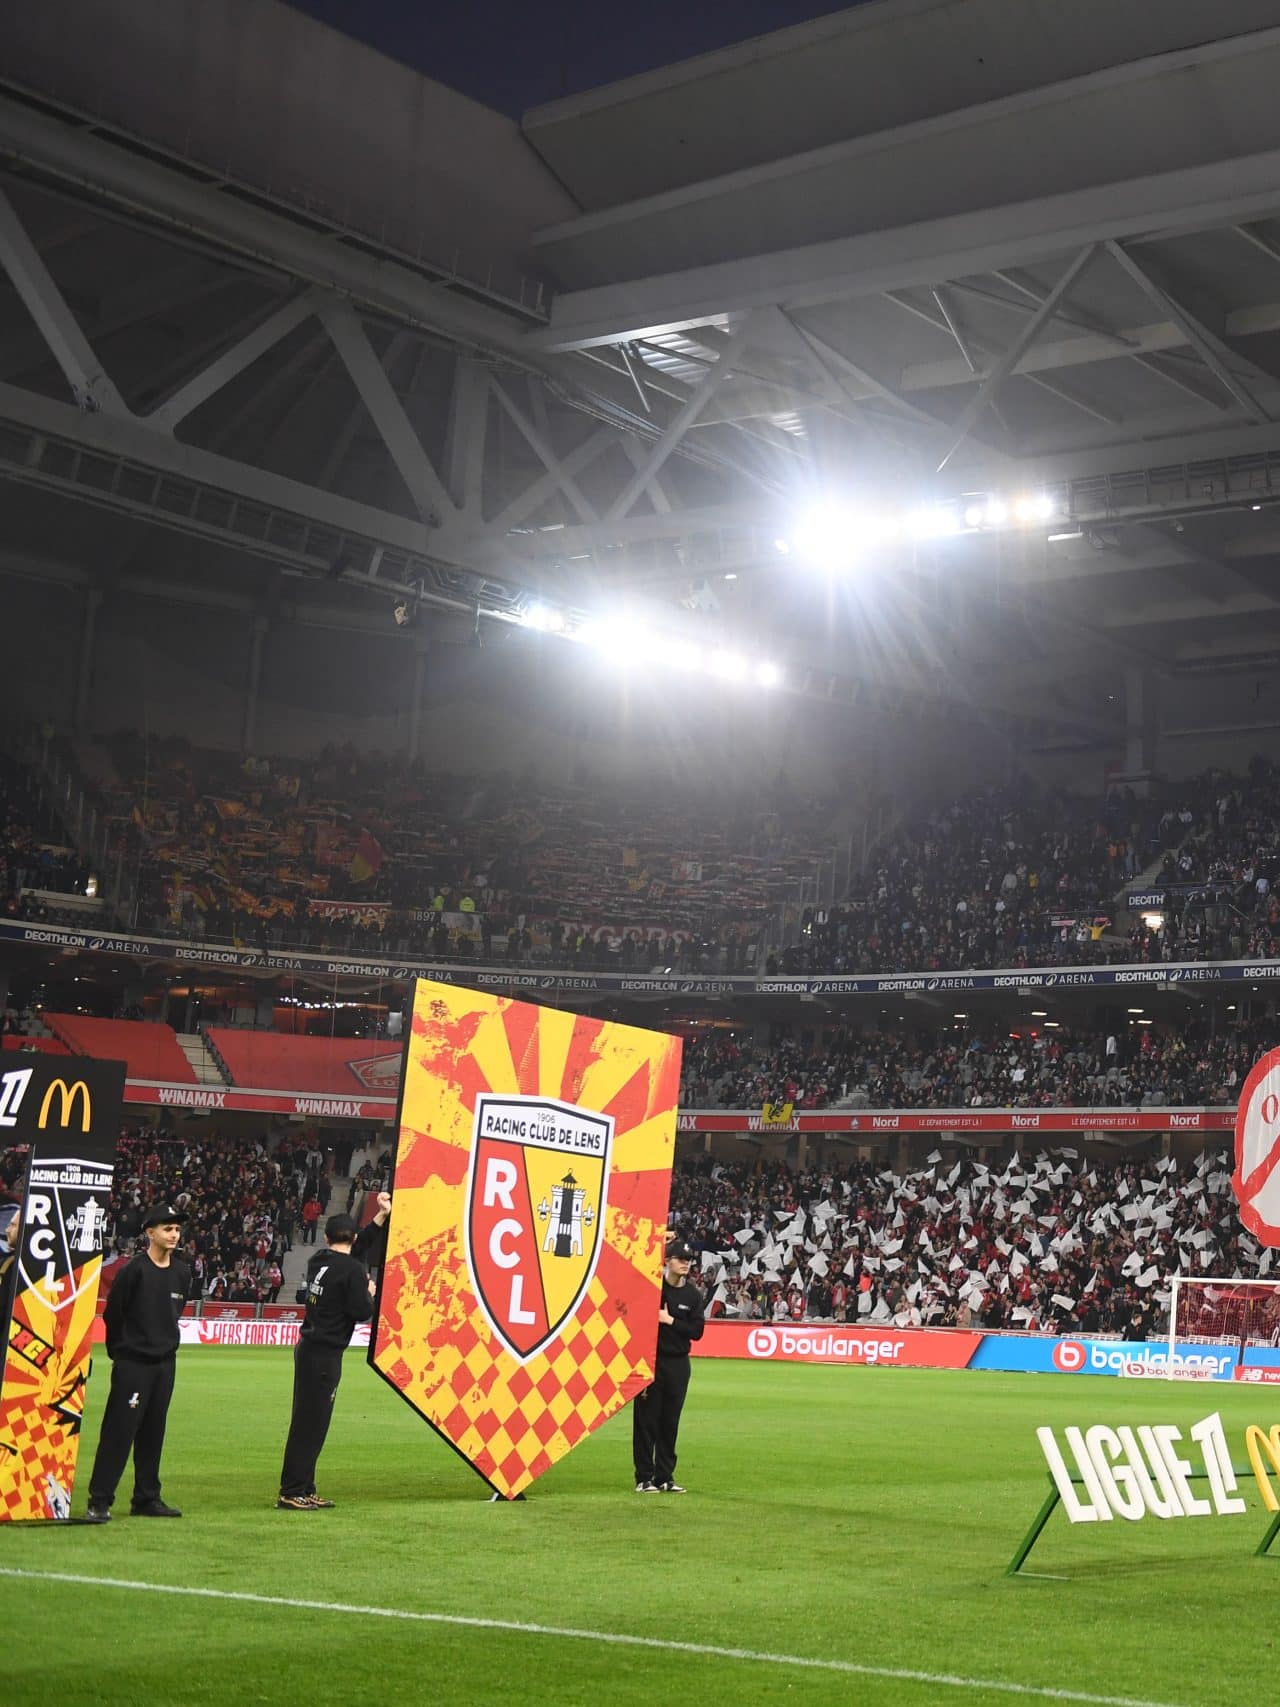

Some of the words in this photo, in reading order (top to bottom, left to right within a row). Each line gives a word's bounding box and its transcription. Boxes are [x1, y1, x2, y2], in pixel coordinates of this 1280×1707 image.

[1128, 895, 1164, 906] DECATH
[25, 929, 85, 947] DECATHLON
[107, 940, 150, 954] ARENA
[175, 948, 238, 964] DECATHLON
[258, 956, 302, 969] ARENA
[327, 962, 389, 977] DECATHLON
[411, 970, 453, 981] ARENA
[1115, 970, 1167, 982] DECATHLON
[1184, 968, 1221, 980] ARENA
[478, 974, 537, 987] DECATHLON
[557, 978, 597, 989] ARENA
[621, 980, 677, 993] DECATHLON
[695, 982, 734, 993] ARENA
[878, 980, 925, 991] DECATHLON
[940, 978, 974, 988] ARENA
[993, 974, 1042, 987] DECATHLON
[1059, 973, 1095, 984] ARENA
[755, 982, 807, 993] DECATHLON
[824, 982, 859, 992] ARENA
[158, 1089, 225, 1107] WINAMAX
[295, 1099, 362, 1116] WINAMAX
[536, 1112, 556, 1125] 1906
[872, 1116, 899, 1128] Nord
[1011, 1115, 1040, 1126] Nord
[1169, 1114, 1200, 1126] Nord
[486, 1115, 527, 1139] RACING
[529, 1122, 556, 1144] CLUB
[558, 1128, 572, 1146] DE
[574, 1131, 601, 1151] LENS
[60, 1172, 81, 1184] CLUB
[82, 1173, 93, 1185] DE
[94, 1175, 113, 1186] LEN
[781, 1333, 905, 1361] boulanger
[1146, 1365, 1210, 1378] bouanger
